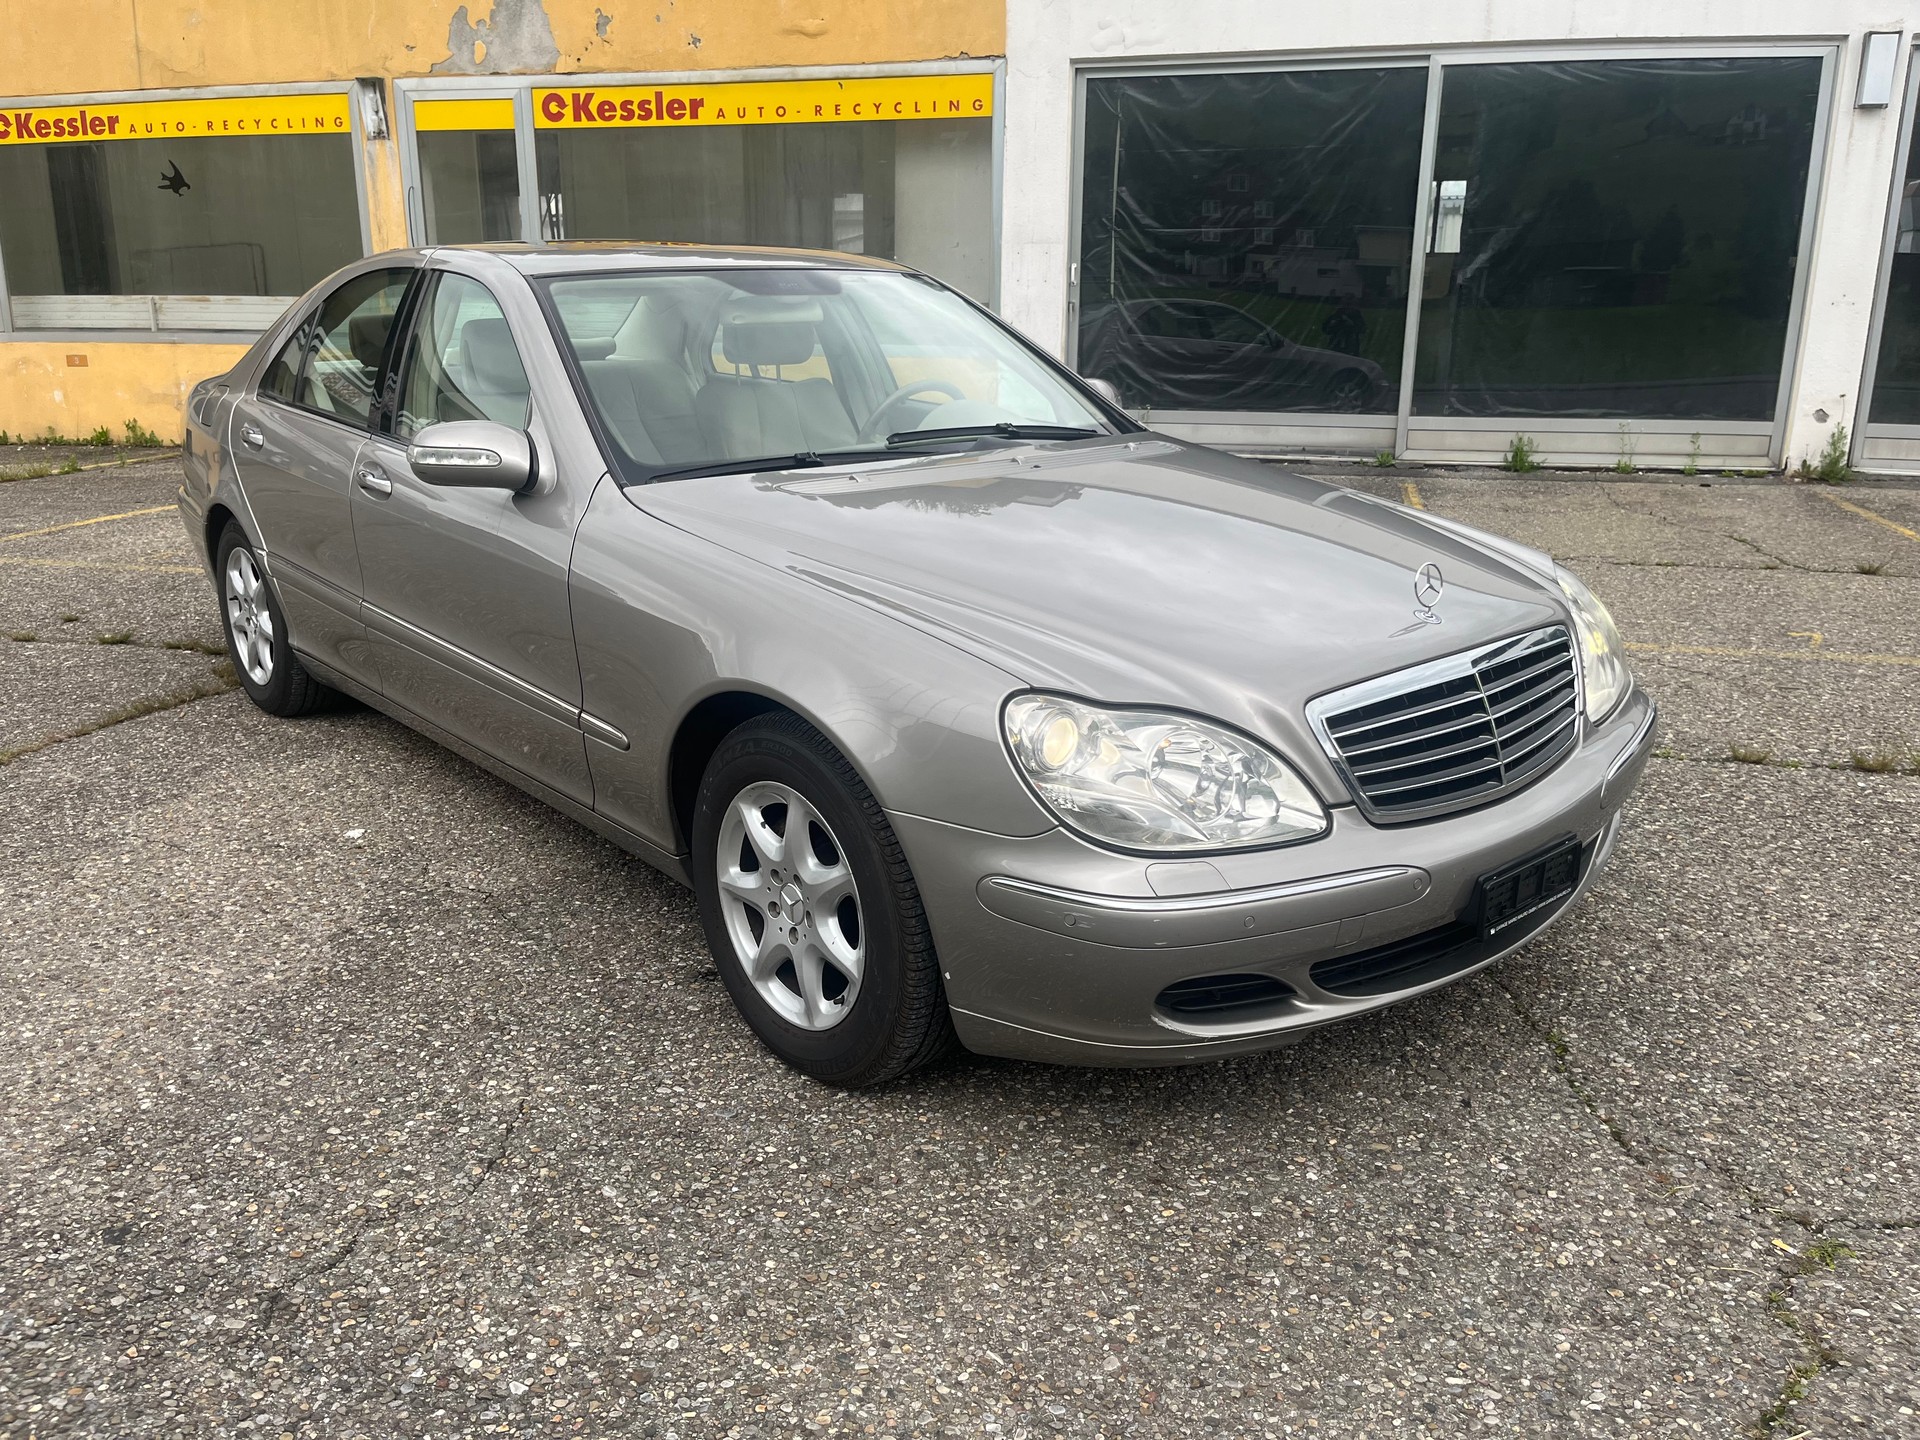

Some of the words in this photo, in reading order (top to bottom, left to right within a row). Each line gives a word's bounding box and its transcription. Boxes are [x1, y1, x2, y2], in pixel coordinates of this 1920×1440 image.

[571, 91, 705, 123] Kessler
[716, 99, 984, 119] AUTO-RECYCLING
[15, 110, 120, 139] Kessler
[129, 117, 344, 135] AUTO-RECYCLING
